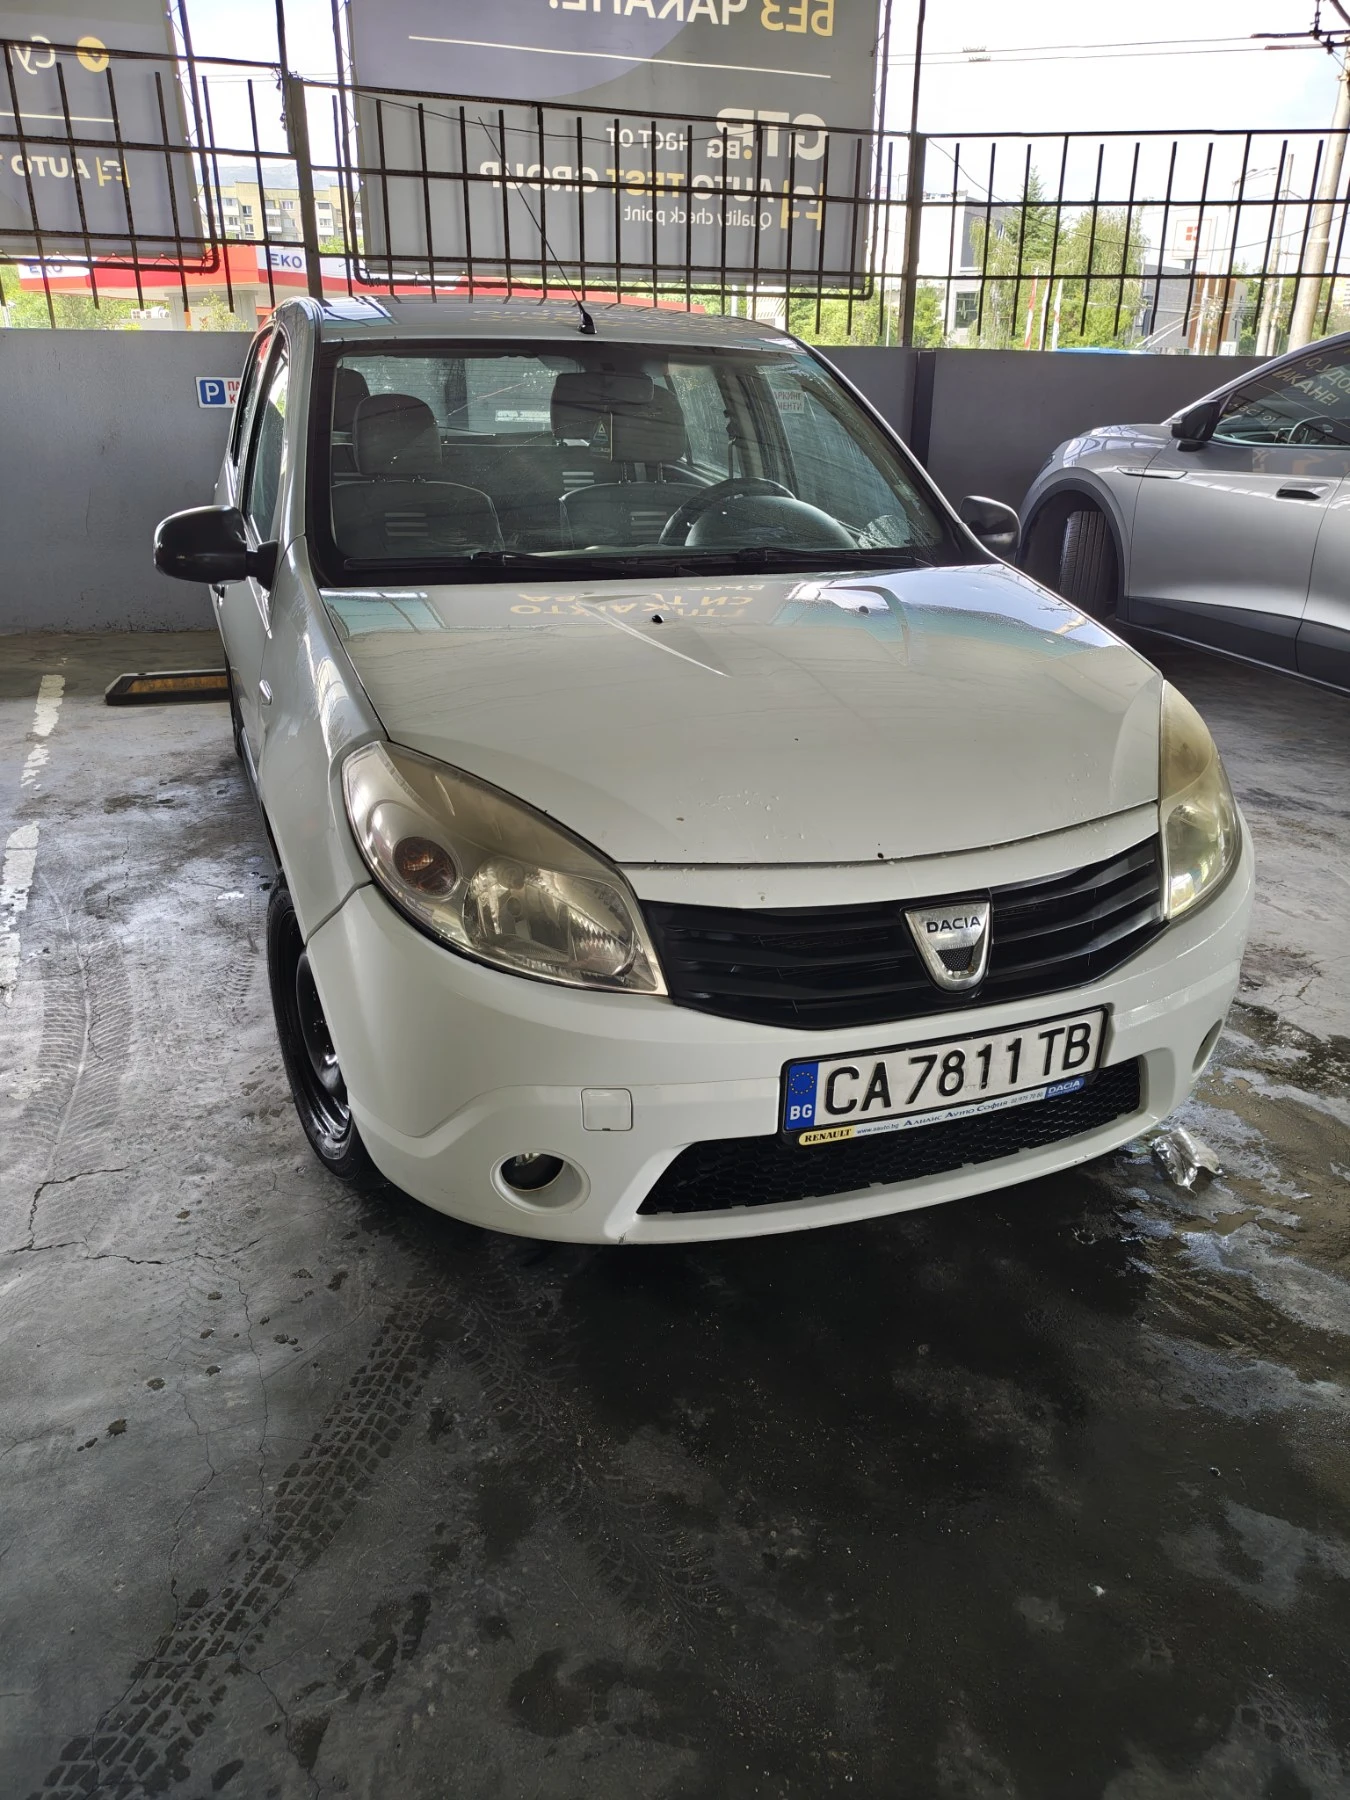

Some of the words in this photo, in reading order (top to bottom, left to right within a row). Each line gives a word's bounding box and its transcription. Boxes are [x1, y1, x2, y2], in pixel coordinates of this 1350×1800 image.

[270, 253, 303, 269] EKO
[29, 263, 63, 275] EO
[926, 916, 981, 933] DACIA
[1048, 1079, 1081, 1094] DACIA
[790, 1104, 813, 1120] BG
[804, 1128, 852, 1143] RENAULT
